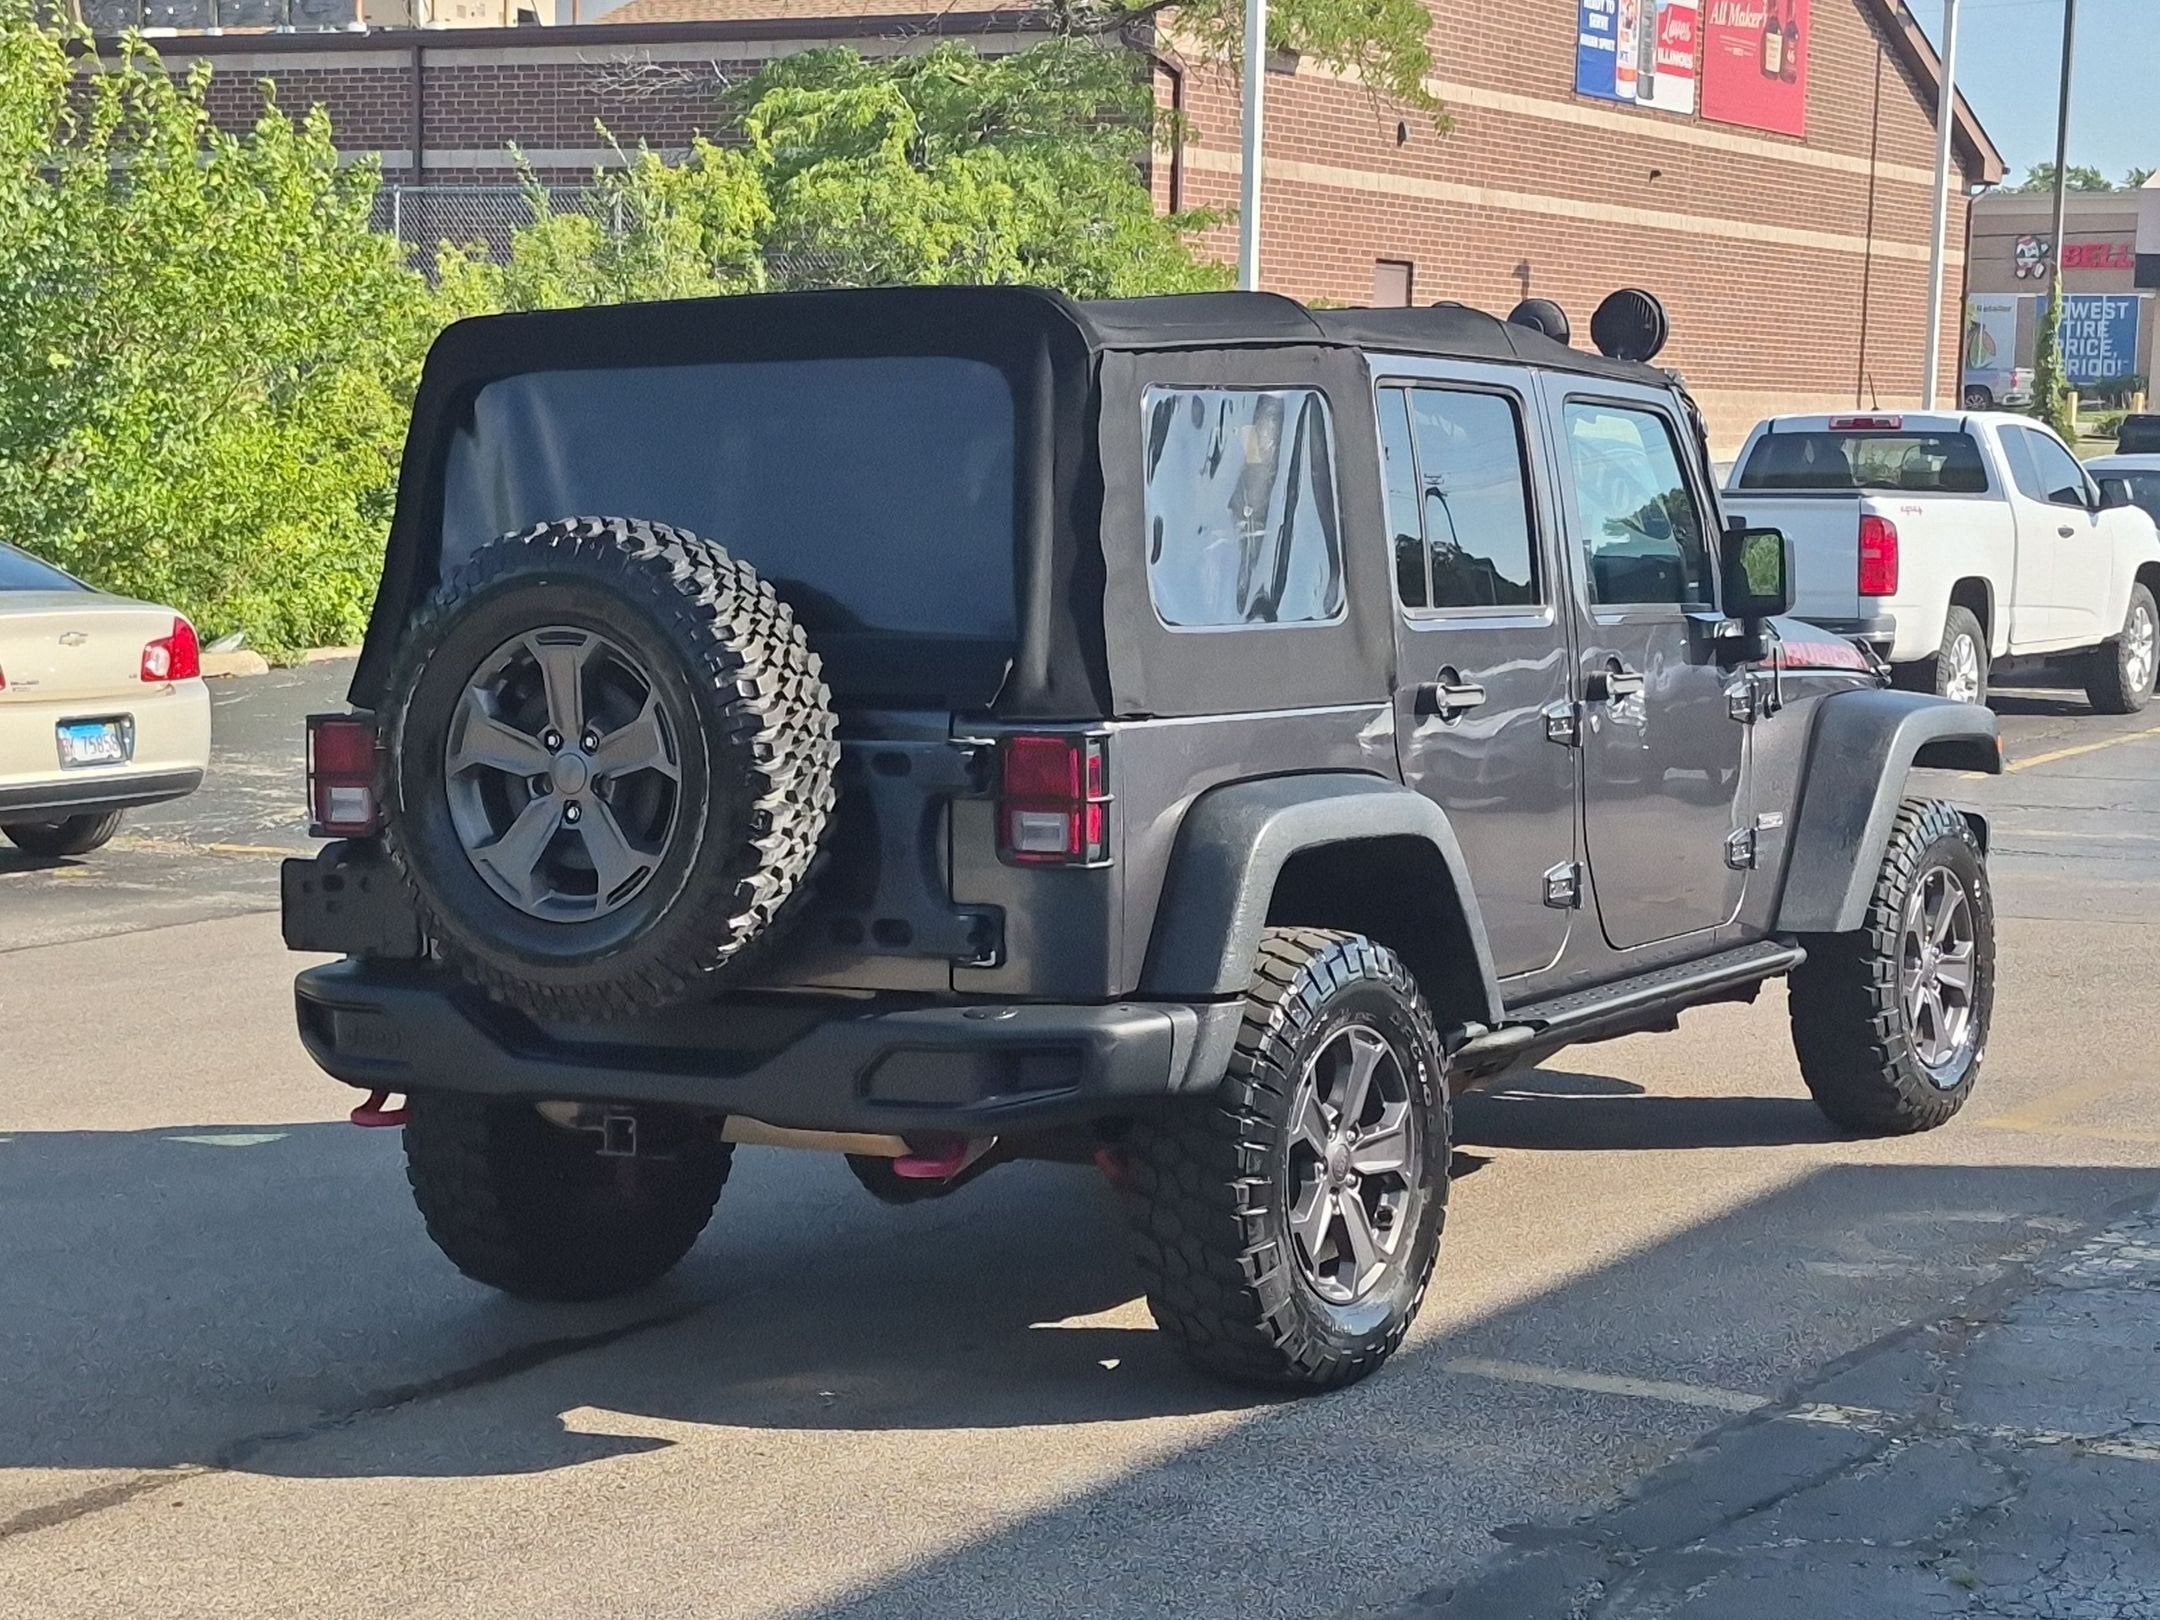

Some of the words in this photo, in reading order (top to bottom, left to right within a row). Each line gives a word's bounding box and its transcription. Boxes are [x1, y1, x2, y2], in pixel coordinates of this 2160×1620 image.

[1709, 1, 1728, 26] All
[1661, 6, 1692, 45] Loves
[1656, 47, 1694, 69] ILLINOIS
[2062, 244, 2134, 269] BELL
[2060, 302, 2129, 320] OWEST
[2063, 321, 2110, 338] TIRE
